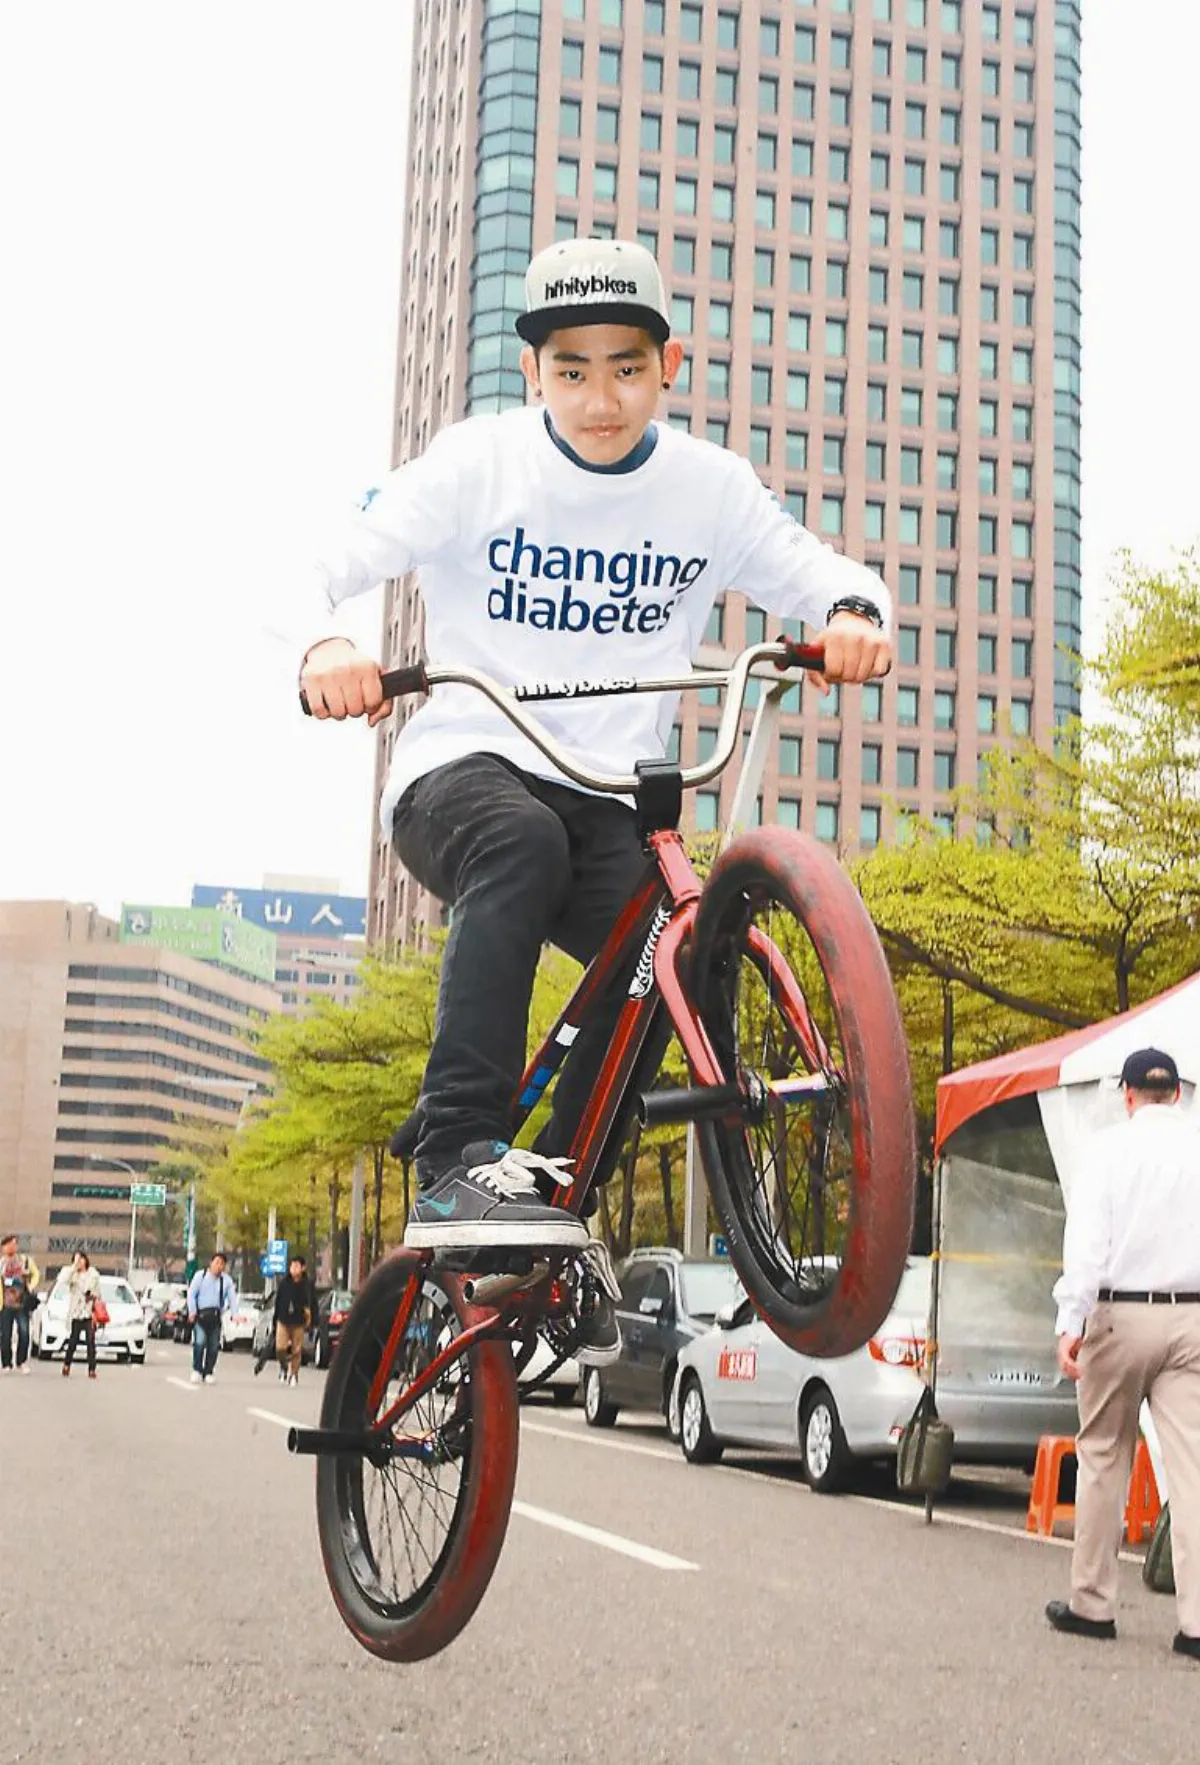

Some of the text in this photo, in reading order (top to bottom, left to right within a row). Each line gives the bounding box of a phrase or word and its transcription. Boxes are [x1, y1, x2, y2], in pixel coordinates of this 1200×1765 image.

[488, 526, 708, 598] changing
[487, 577, 675, 635] diabetes
[216, 889, 366, 927] 南山人
